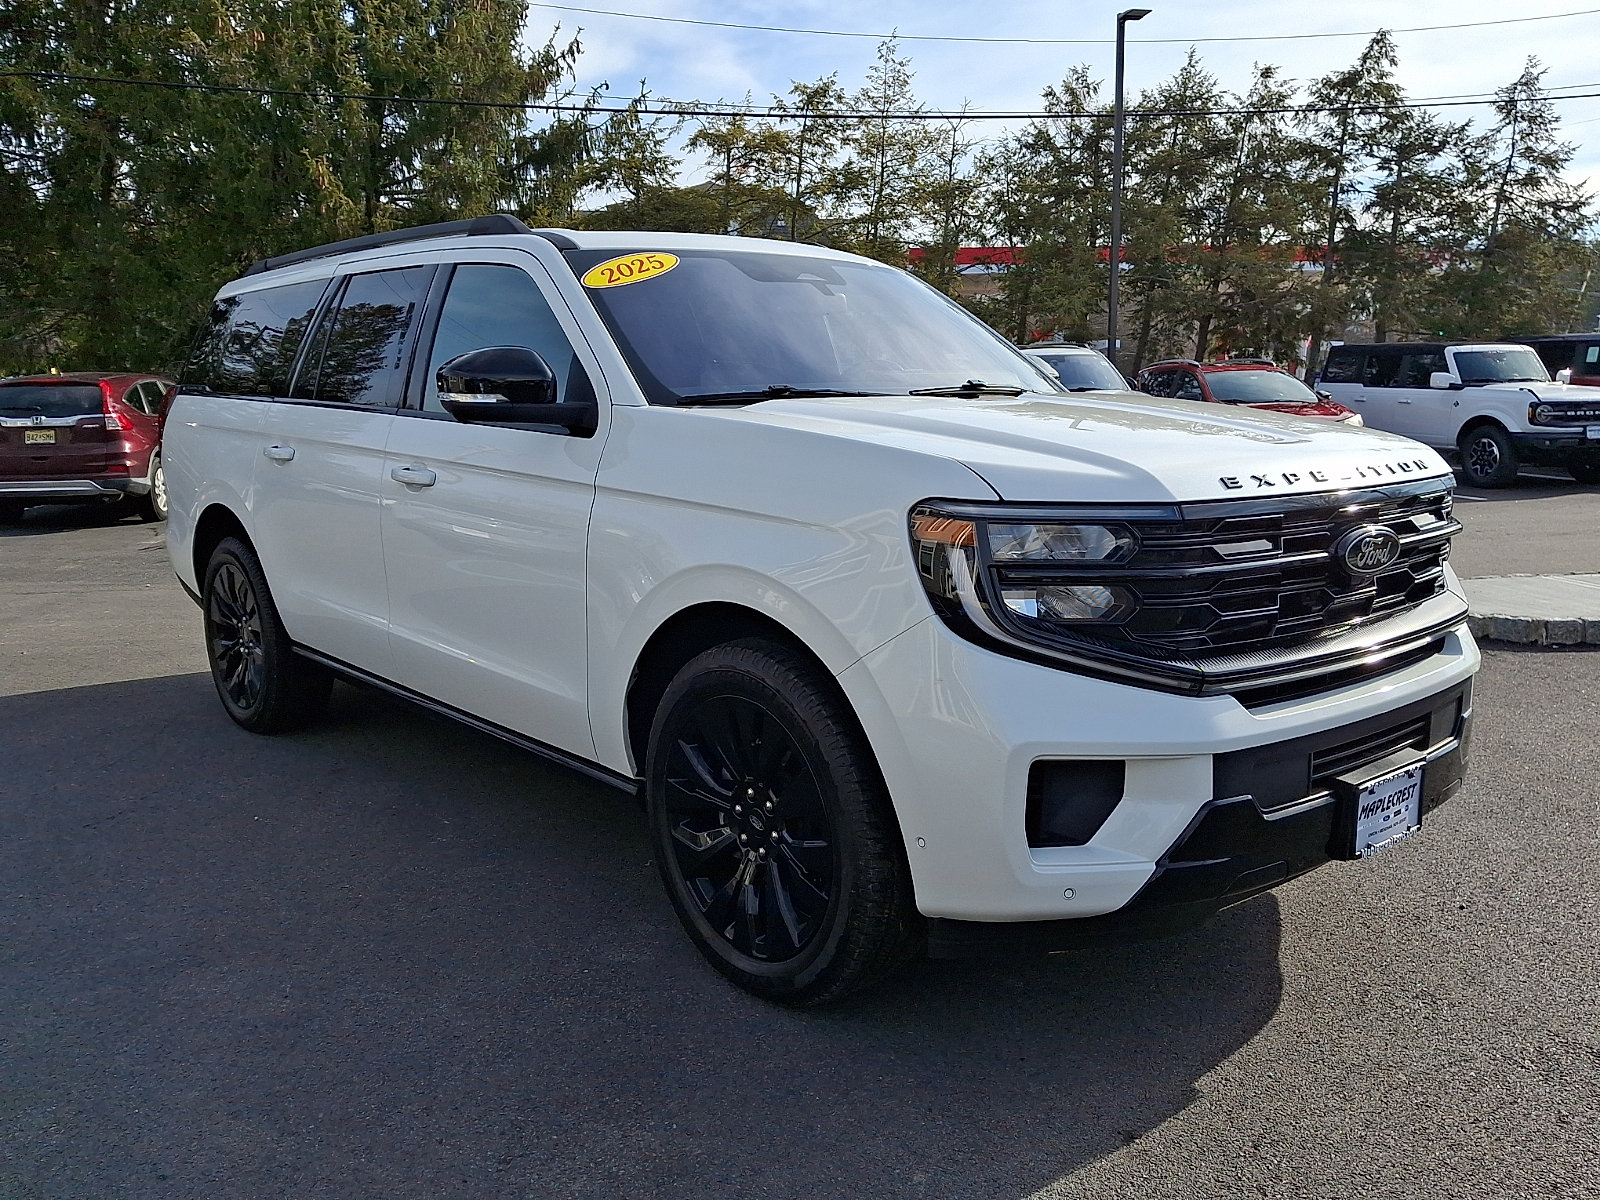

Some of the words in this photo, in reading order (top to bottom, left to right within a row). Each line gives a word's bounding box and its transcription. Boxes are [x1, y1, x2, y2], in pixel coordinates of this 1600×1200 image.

[600, 255, 665, 284] 2025
[1357, 536, 1392, 568] Ford
[1358, 782, 1418, 821] MAPLECREST
